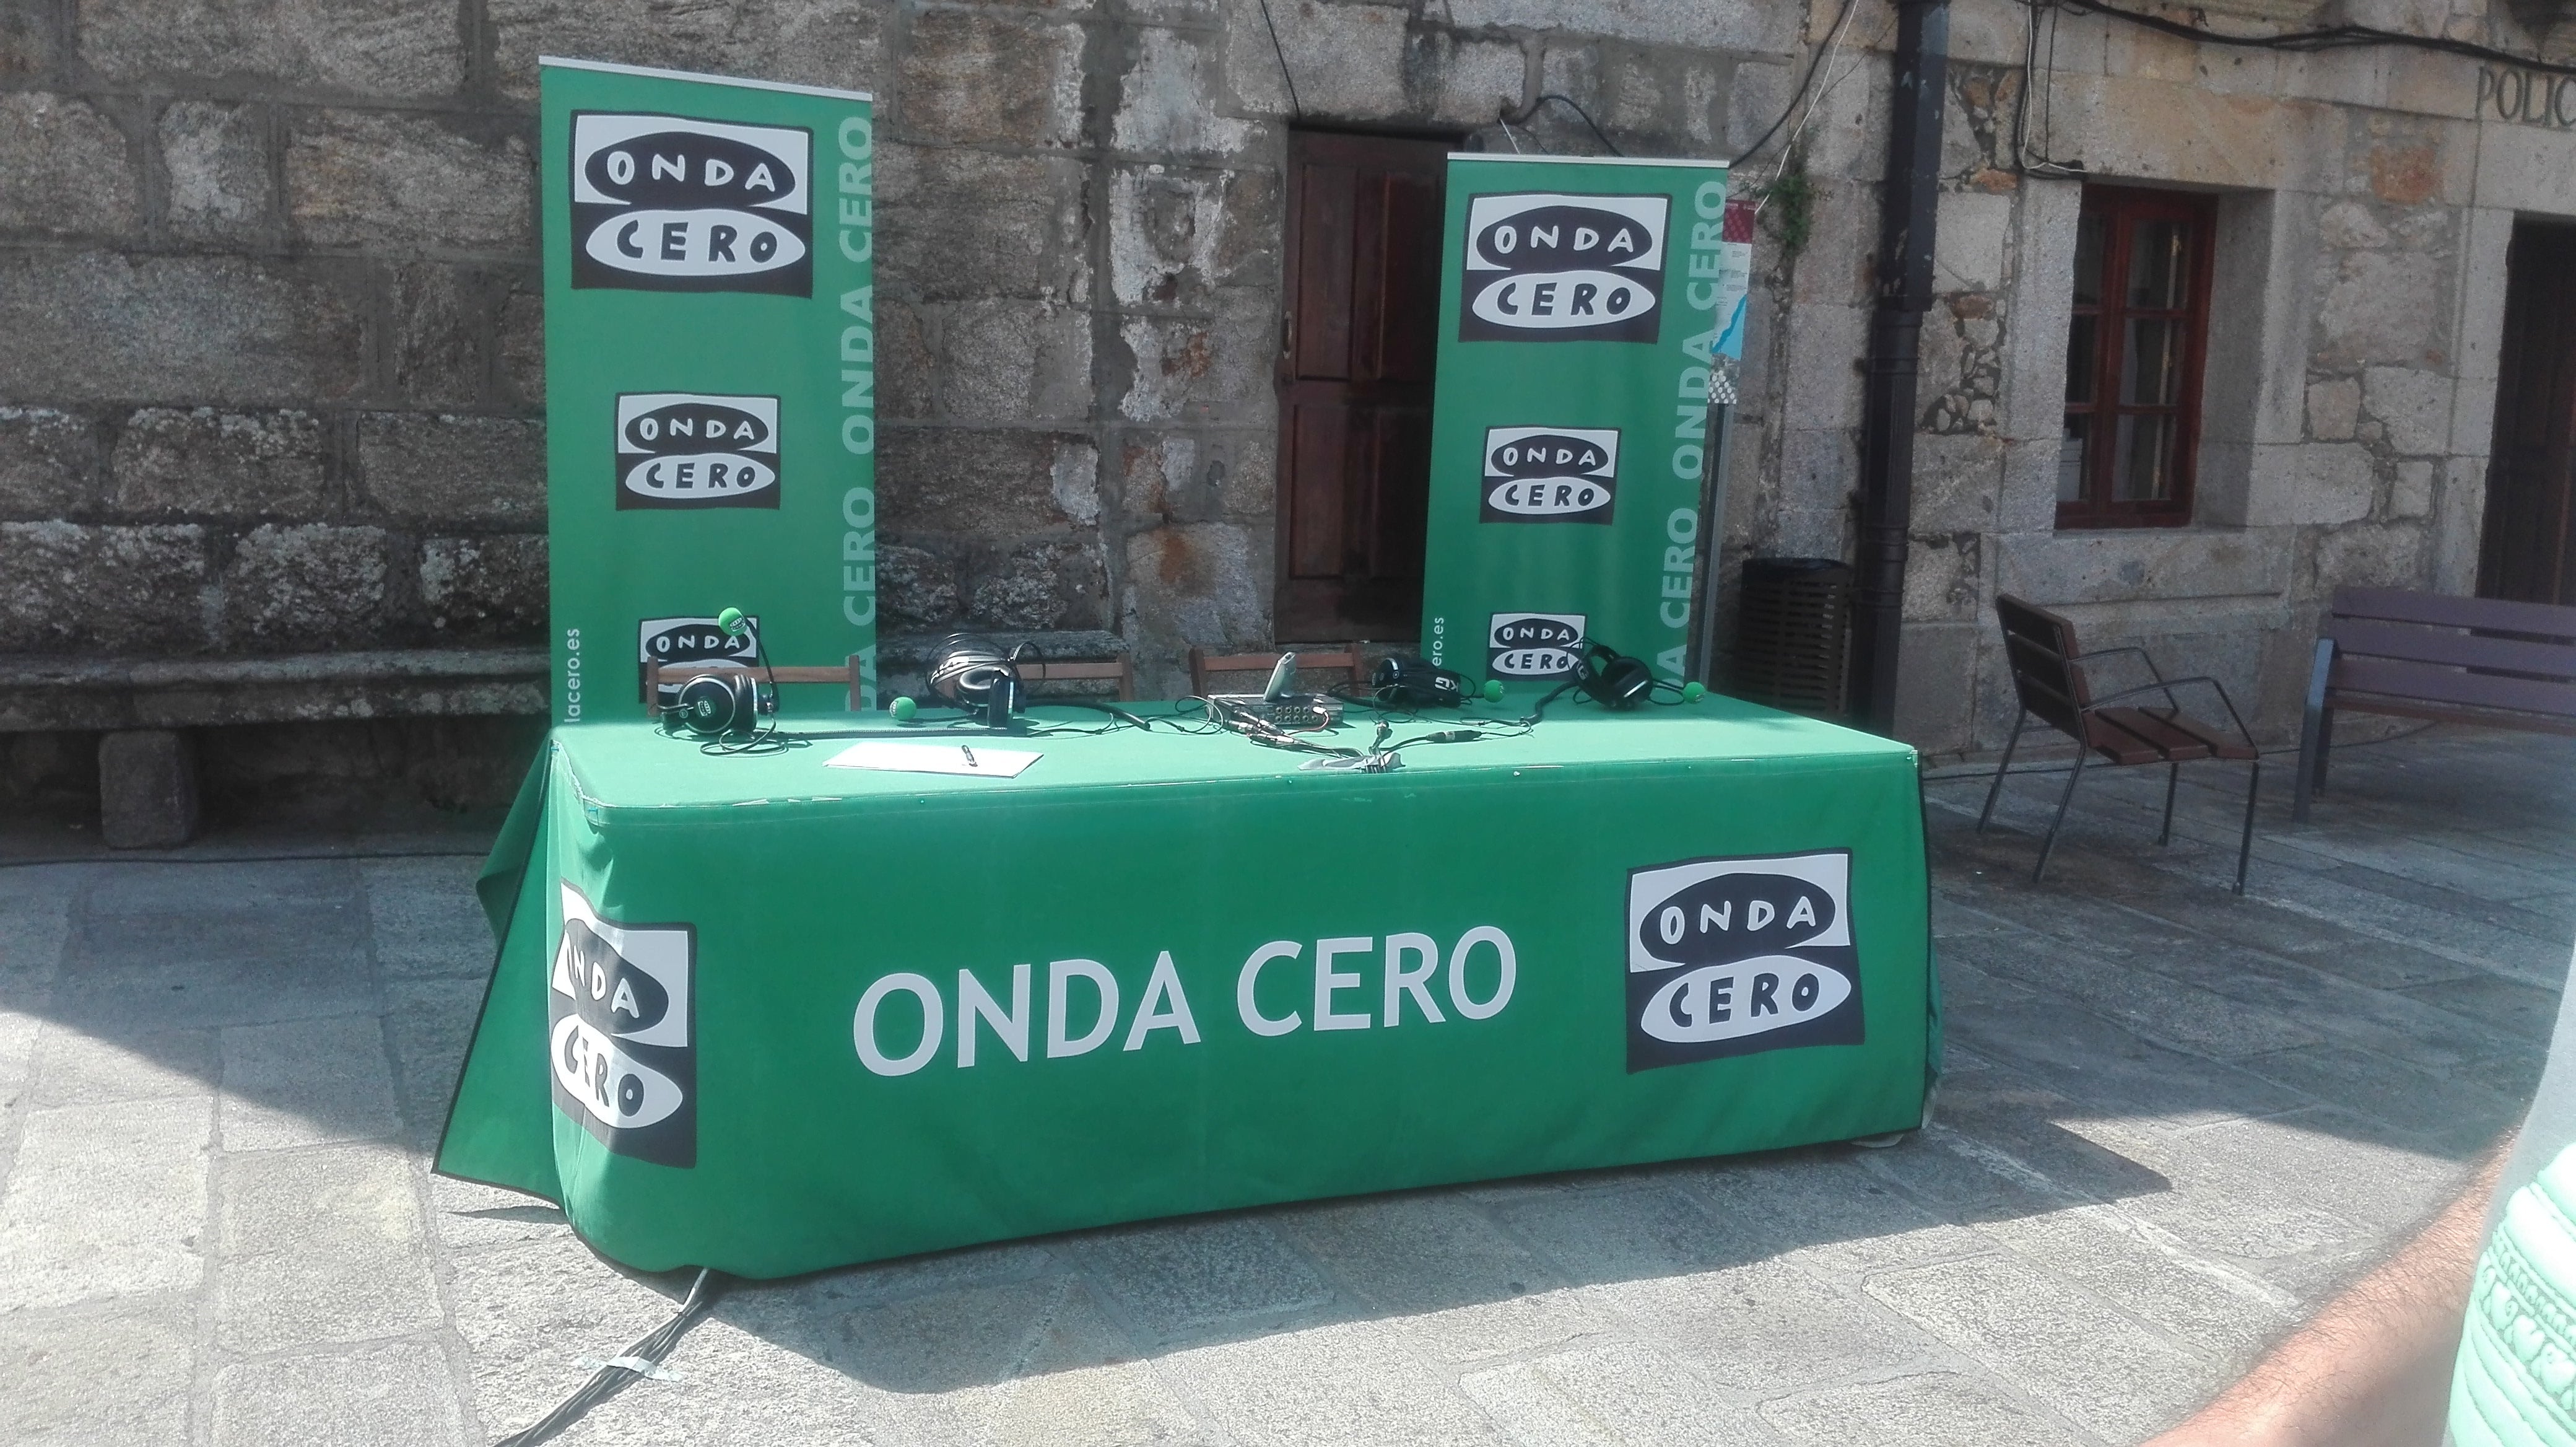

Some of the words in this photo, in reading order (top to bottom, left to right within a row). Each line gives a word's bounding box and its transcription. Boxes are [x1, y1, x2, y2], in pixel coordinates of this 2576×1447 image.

[607, 151, 776, 192] ONDA
[838, 116, 872, 263] CERO
[616, 219, 778, 263] CERO
[1494, 225, 1634, 254] ONDA
[1686, 181, 1727, 311] CERO
[1497, 282, 1631, 316] CERO
[840, 284, 874, 455] ONDA
[1671, 328, 1715, 480] ONDA
[640, 417, 755, 441] ONDA
[646, 462, 756, 489] CERO
[1503, 447, 1596, 466] ONDA
[1504, 484, 1595, 507] CERO
[842, 487, 877, 626] CERO
[1660, 507, 1699, 629] CERO
[656, 635, 740, 652] ONDA
[1502, 627, 1570, 640] ONDA
[1503, 653, 1569, 670] CERO
[1435, 677, 1459, 692] KG
[1660, 896, 1816, 945] ONDA
[567, 944, 640, 1019] NDA
[853, 950, 1201, 1077] ONDA
[1237, 925, 1518, 1037] CERO
[1669, 973, 1820, 1028] CERO
